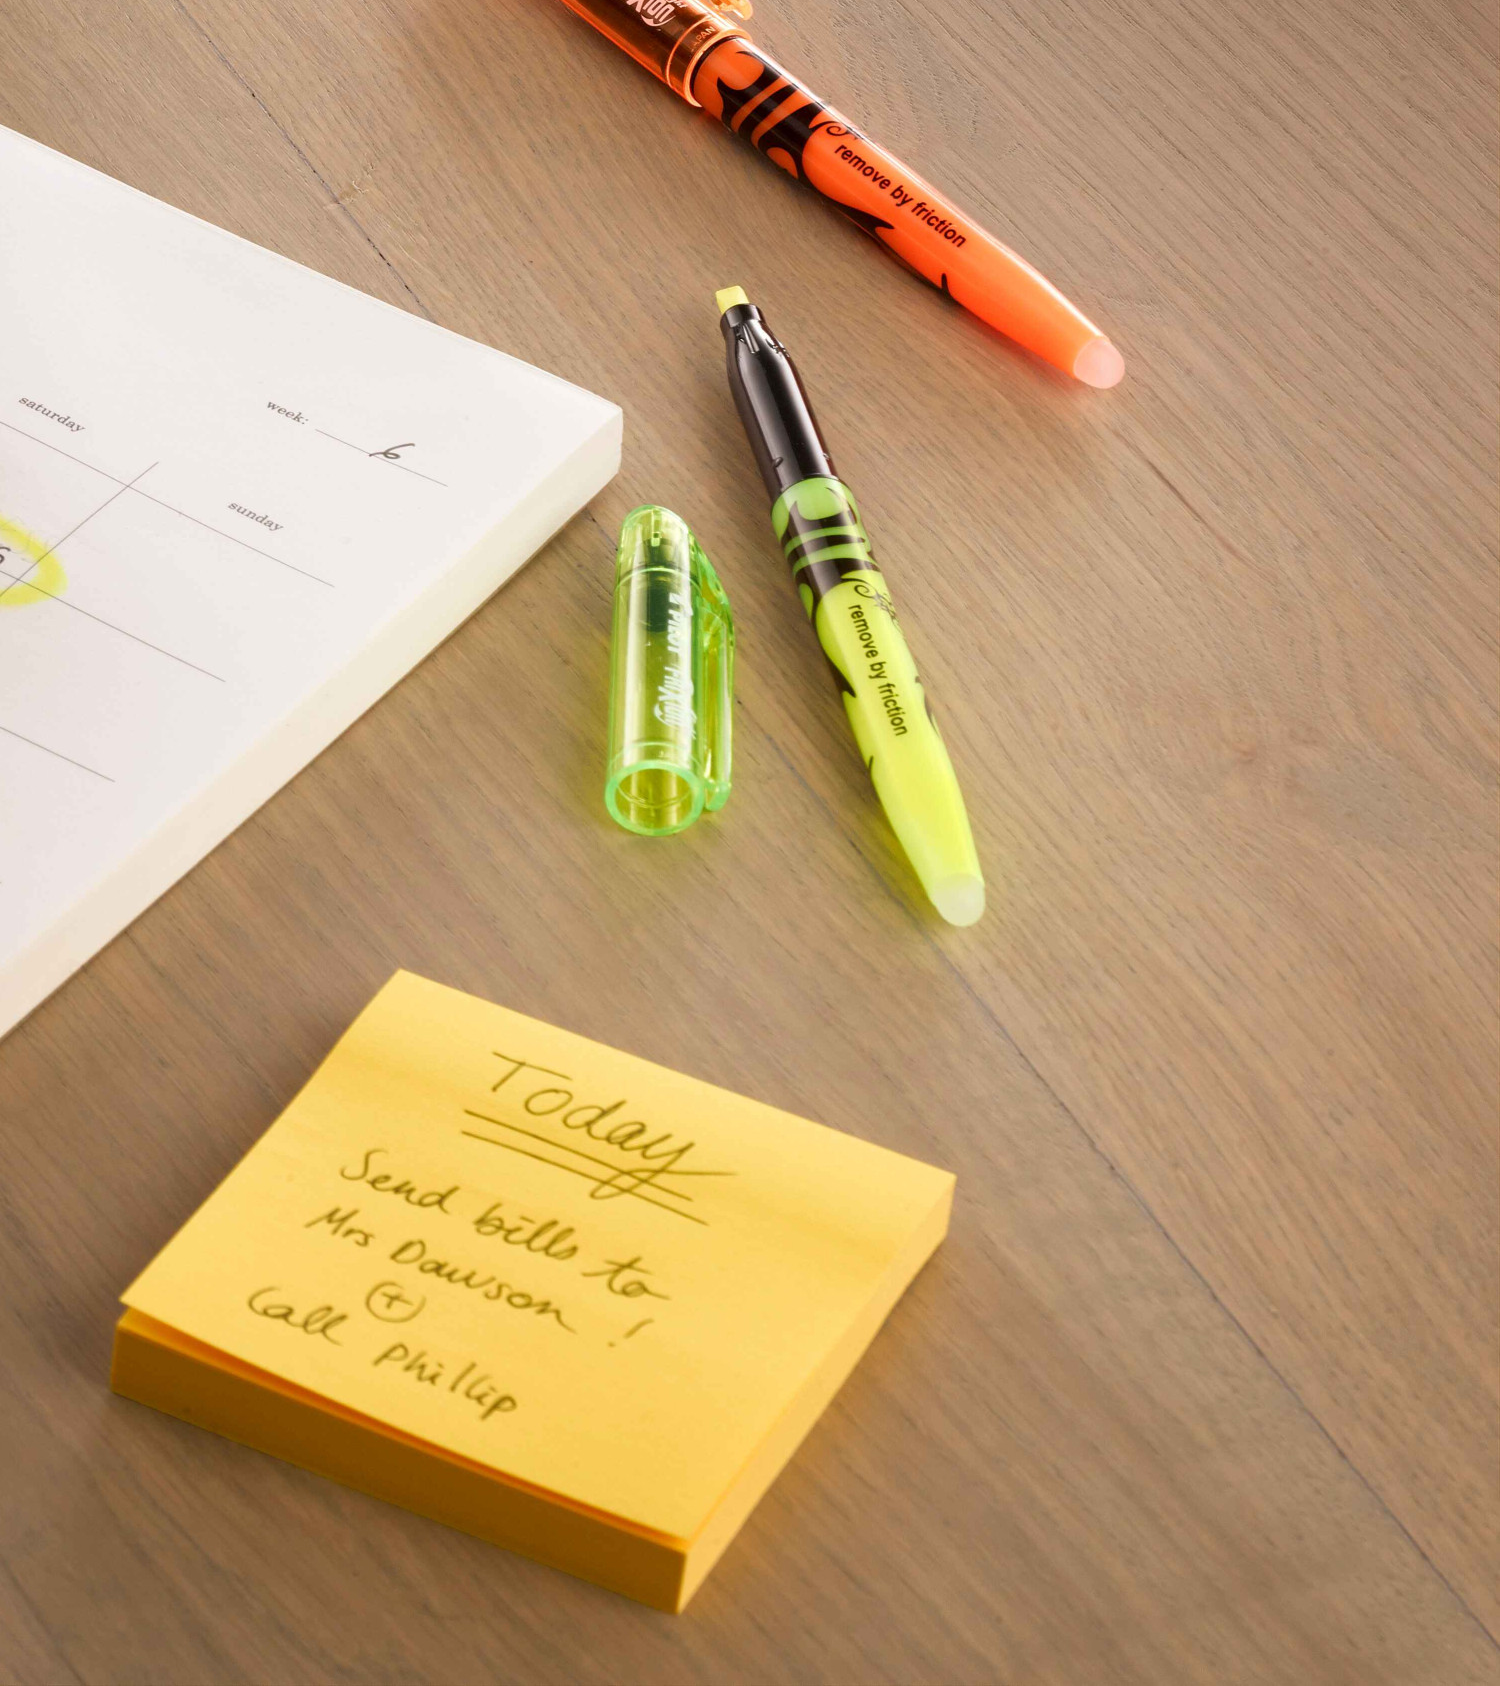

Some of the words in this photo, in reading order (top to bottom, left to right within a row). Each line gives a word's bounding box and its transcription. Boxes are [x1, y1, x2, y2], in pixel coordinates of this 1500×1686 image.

[833, 139, 893, 193] remove
[891, 182, 914, 209] by
[911, 199, 970, 251] friction
[18, 393, 87, 435] saturday
[265, 398, 310, 426] week:
[227, 499, 285, 534] sunday
[847, 603, 881, 660] remove
[867, 656, 888, 682] by
[877, 680, 910, 738] friction
[490, 1050, 730, 1196] Today
[339, 1147, 454, 1216] Send
[472, 1200, 579, 1263] bills
[581, 1247, 673, 1304] to
[304, 1207, 374, 1251] Mrs
[388, 1238, 579, 1334] Dawson
[247, 1284, 345, 1346] Call
